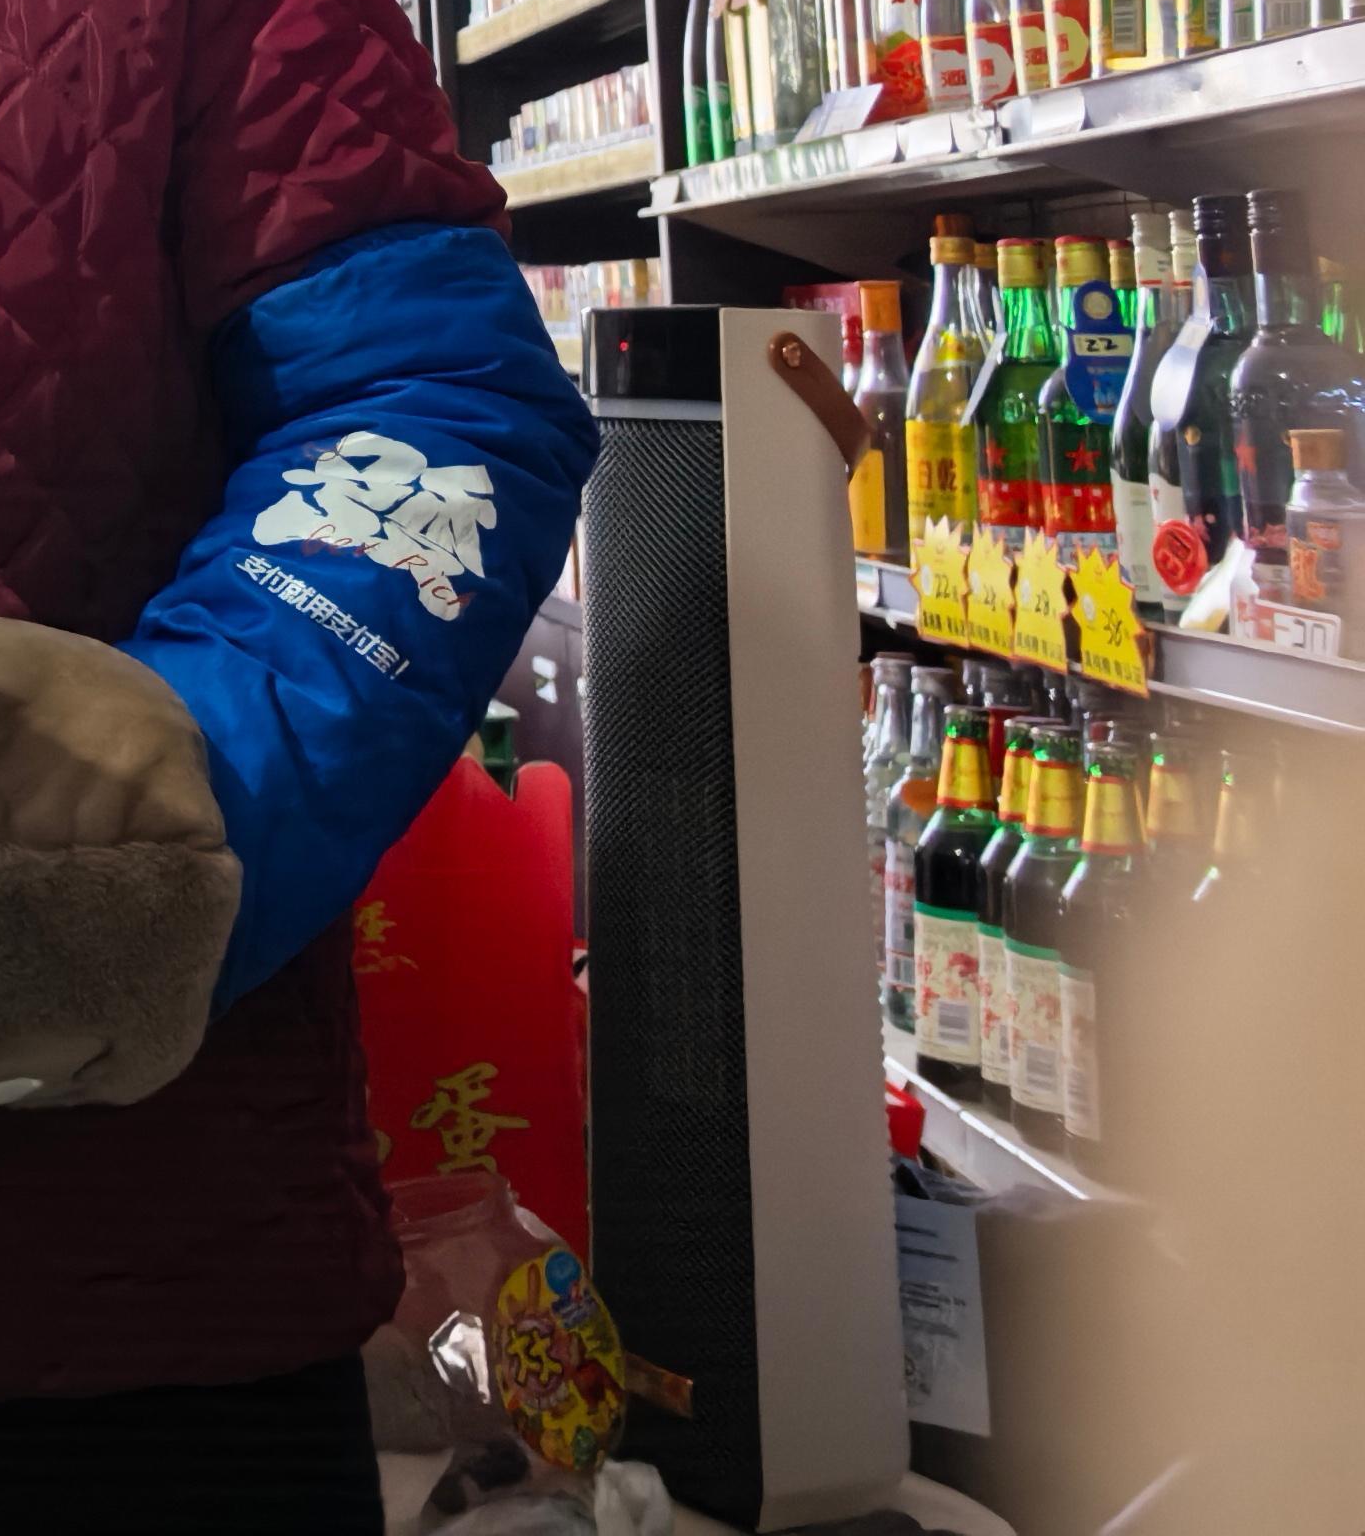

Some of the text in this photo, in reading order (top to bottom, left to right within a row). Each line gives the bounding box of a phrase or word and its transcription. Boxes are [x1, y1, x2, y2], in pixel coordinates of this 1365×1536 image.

[1085, 337, 1118, 353] 22
[235, 554, 411, 681] 支付就用支付宝!
[373, 1060, 532, 1177] 蛋
